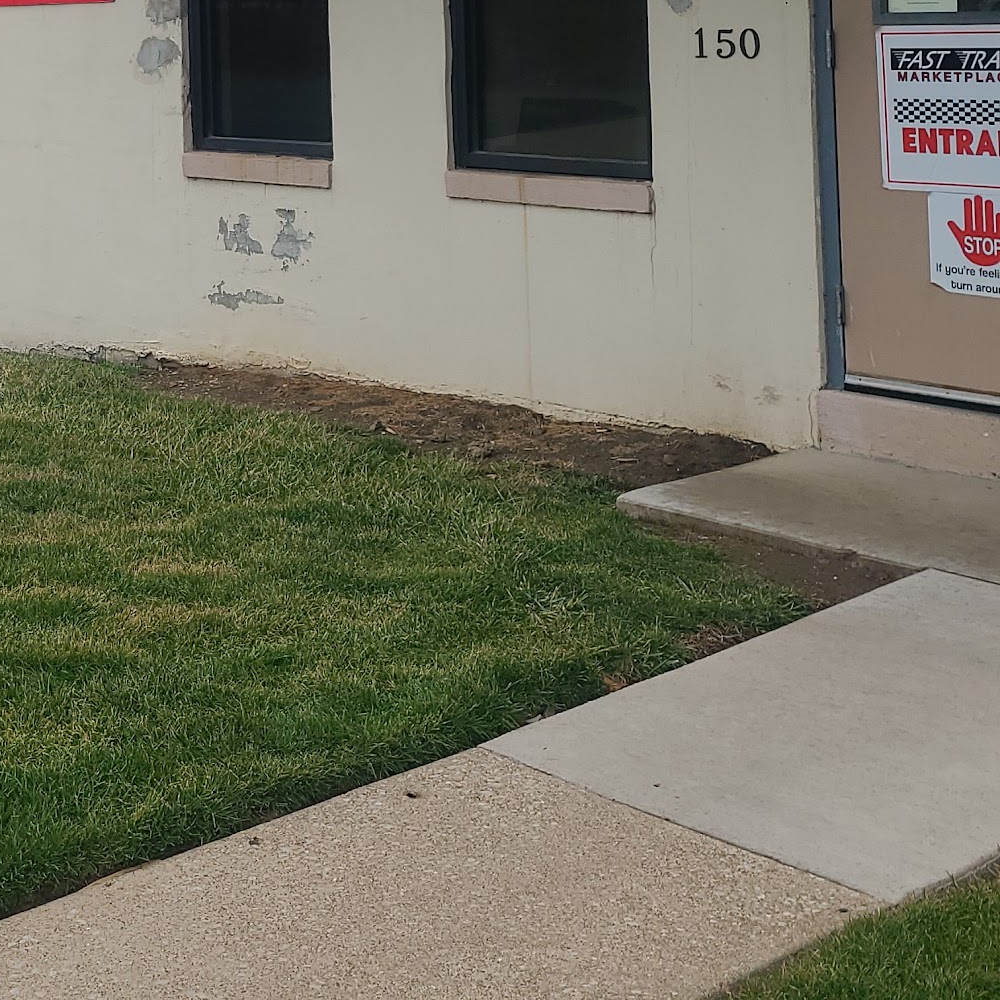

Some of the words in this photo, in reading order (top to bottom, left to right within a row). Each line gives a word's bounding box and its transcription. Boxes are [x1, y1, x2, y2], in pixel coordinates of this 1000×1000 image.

[694, 27, 760, 59] 150
[892, 51, 951, 69] FAST
[897, 72, 1000, 82] MARKETPLA
[902, 127, 1000, 157] ENTRA
[936, 262, 942, 272] If
[945, 265, 976, 276] you're
[951, 280, 973, 291] turn
